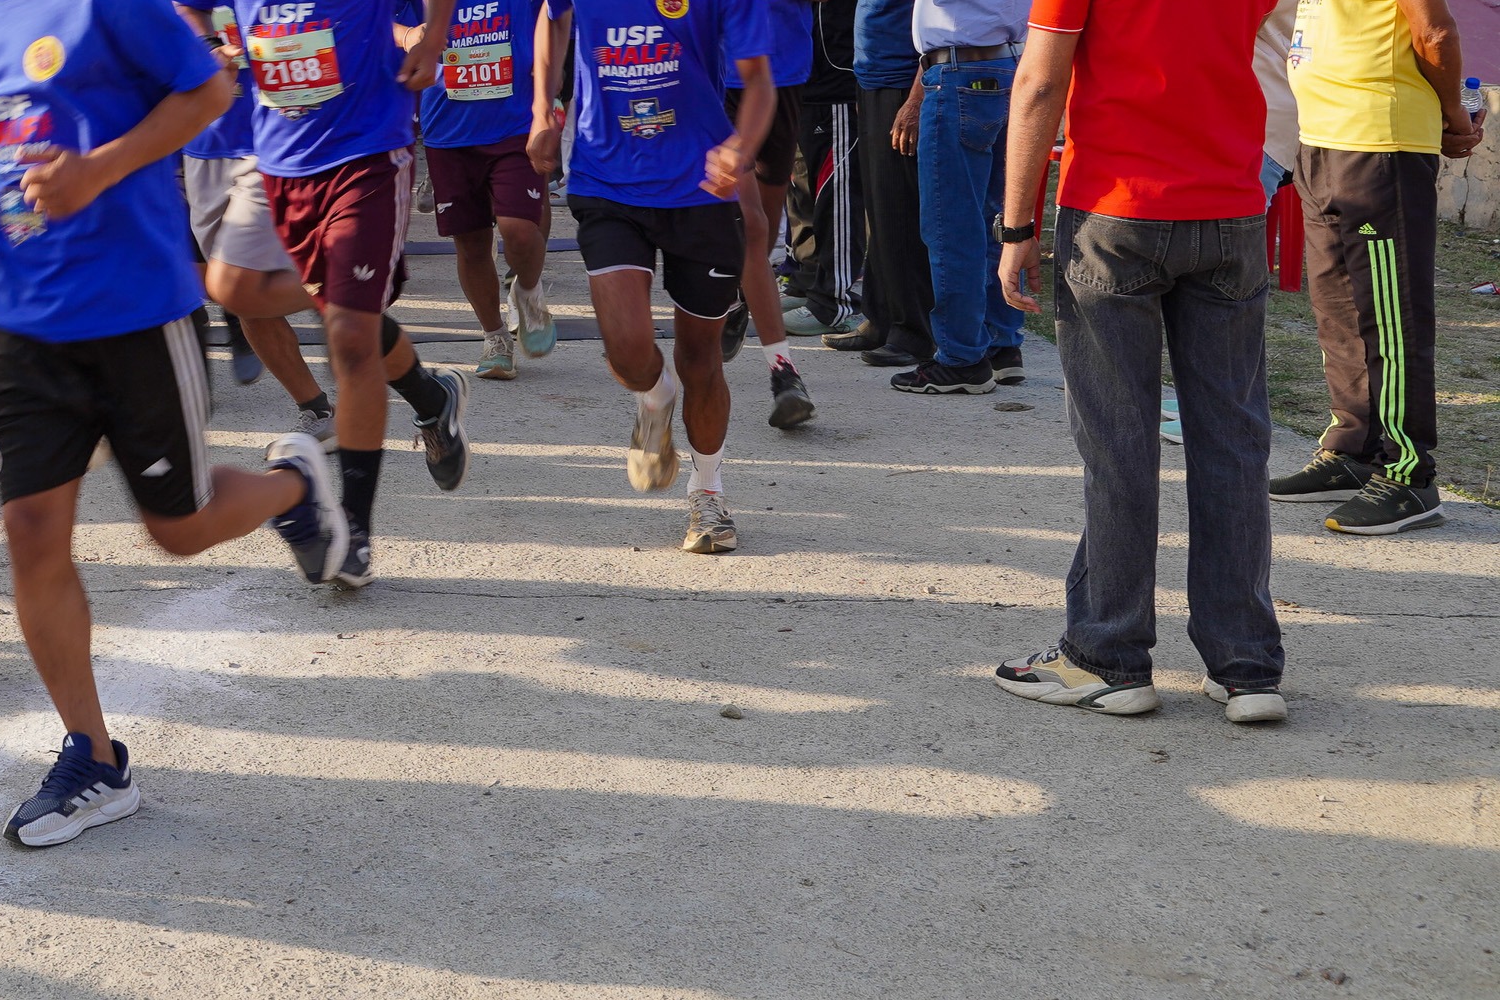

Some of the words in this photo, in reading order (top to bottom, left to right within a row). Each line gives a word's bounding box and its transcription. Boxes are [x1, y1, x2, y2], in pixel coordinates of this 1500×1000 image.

[258, 2, 316, 25] USF
[457, 1, 499, 24] USF
[453, 15, 503, 39] HALF
[606, 25, 665, 47] USF
[451, 30, 510, 49] MARATHON!
[604, 42, 671, 66] HALF
[261, 57, 323, 85] 2188
[456, 62, 501, 84] 2101
[597, 59, 680, 78] MARATHON!
